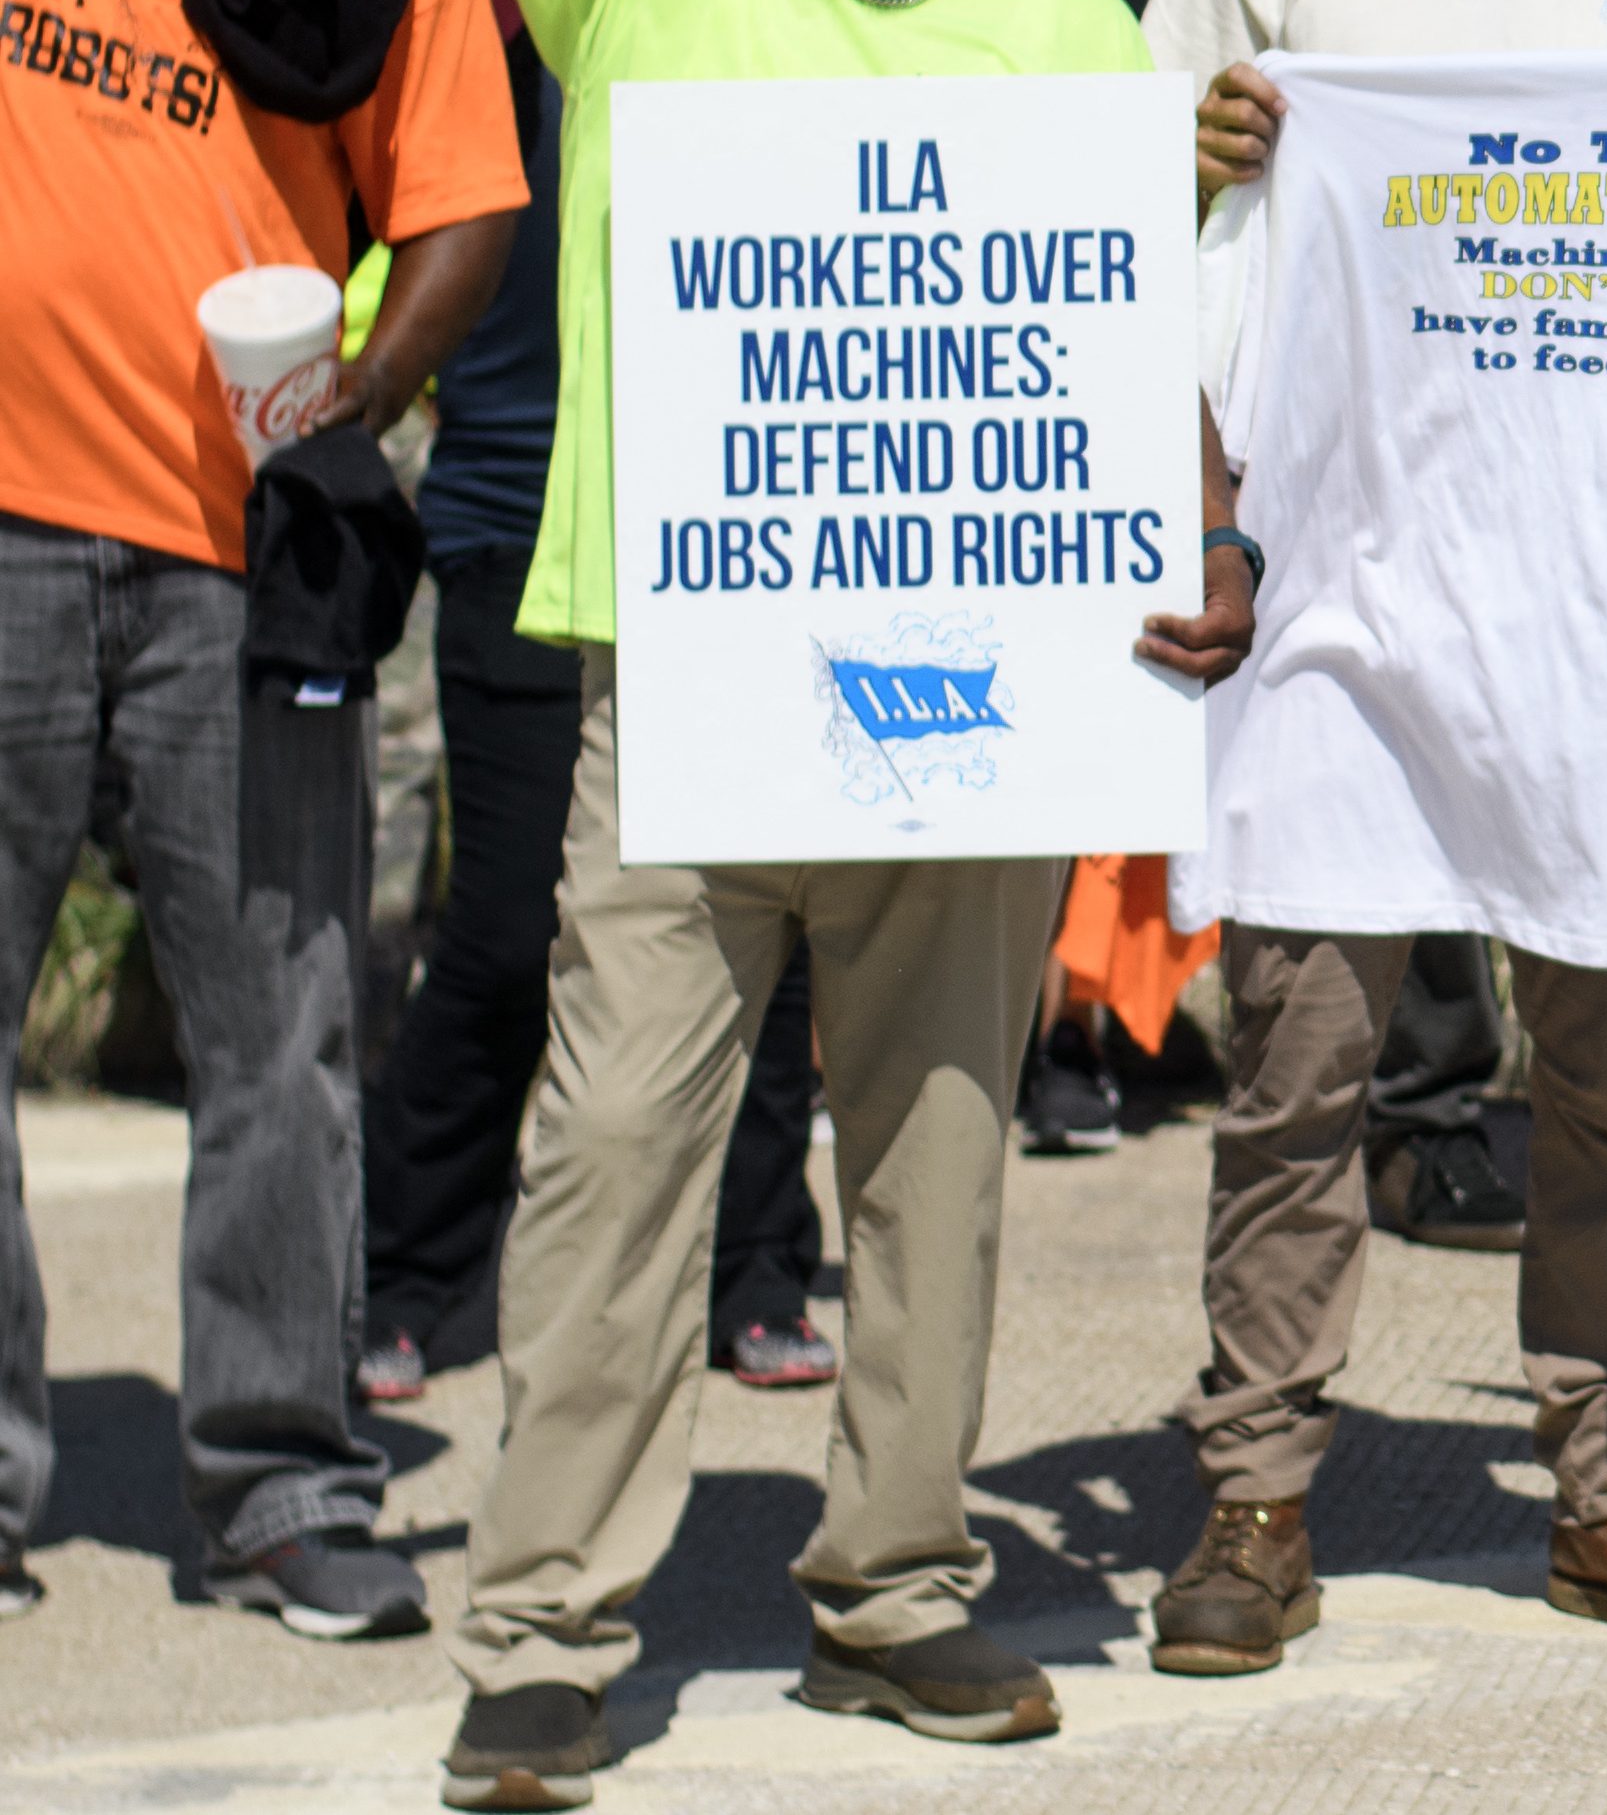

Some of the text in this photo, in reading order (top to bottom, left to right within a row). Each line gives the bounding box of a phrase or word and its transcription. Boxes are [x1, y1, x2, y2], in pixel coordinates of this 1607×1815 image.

[0, 0, 220, 135] ROBOTS!
[857, 139, 949, 215] ILA
[1469, 133, 1562, 166] No
[670, 228, 1137, 312] WORKERS OVER
[1412, 306, 1518, 337] have
[1473, 346, 1518, 372] to
[740, 324, 1070, 404] MACHINES:
[723, 416, 1091, 498] DEFEND OUR
[651, 509, 1165, 594] JOBS AND RIGHTS
[857, 676, 991, 722] I.L.A.
